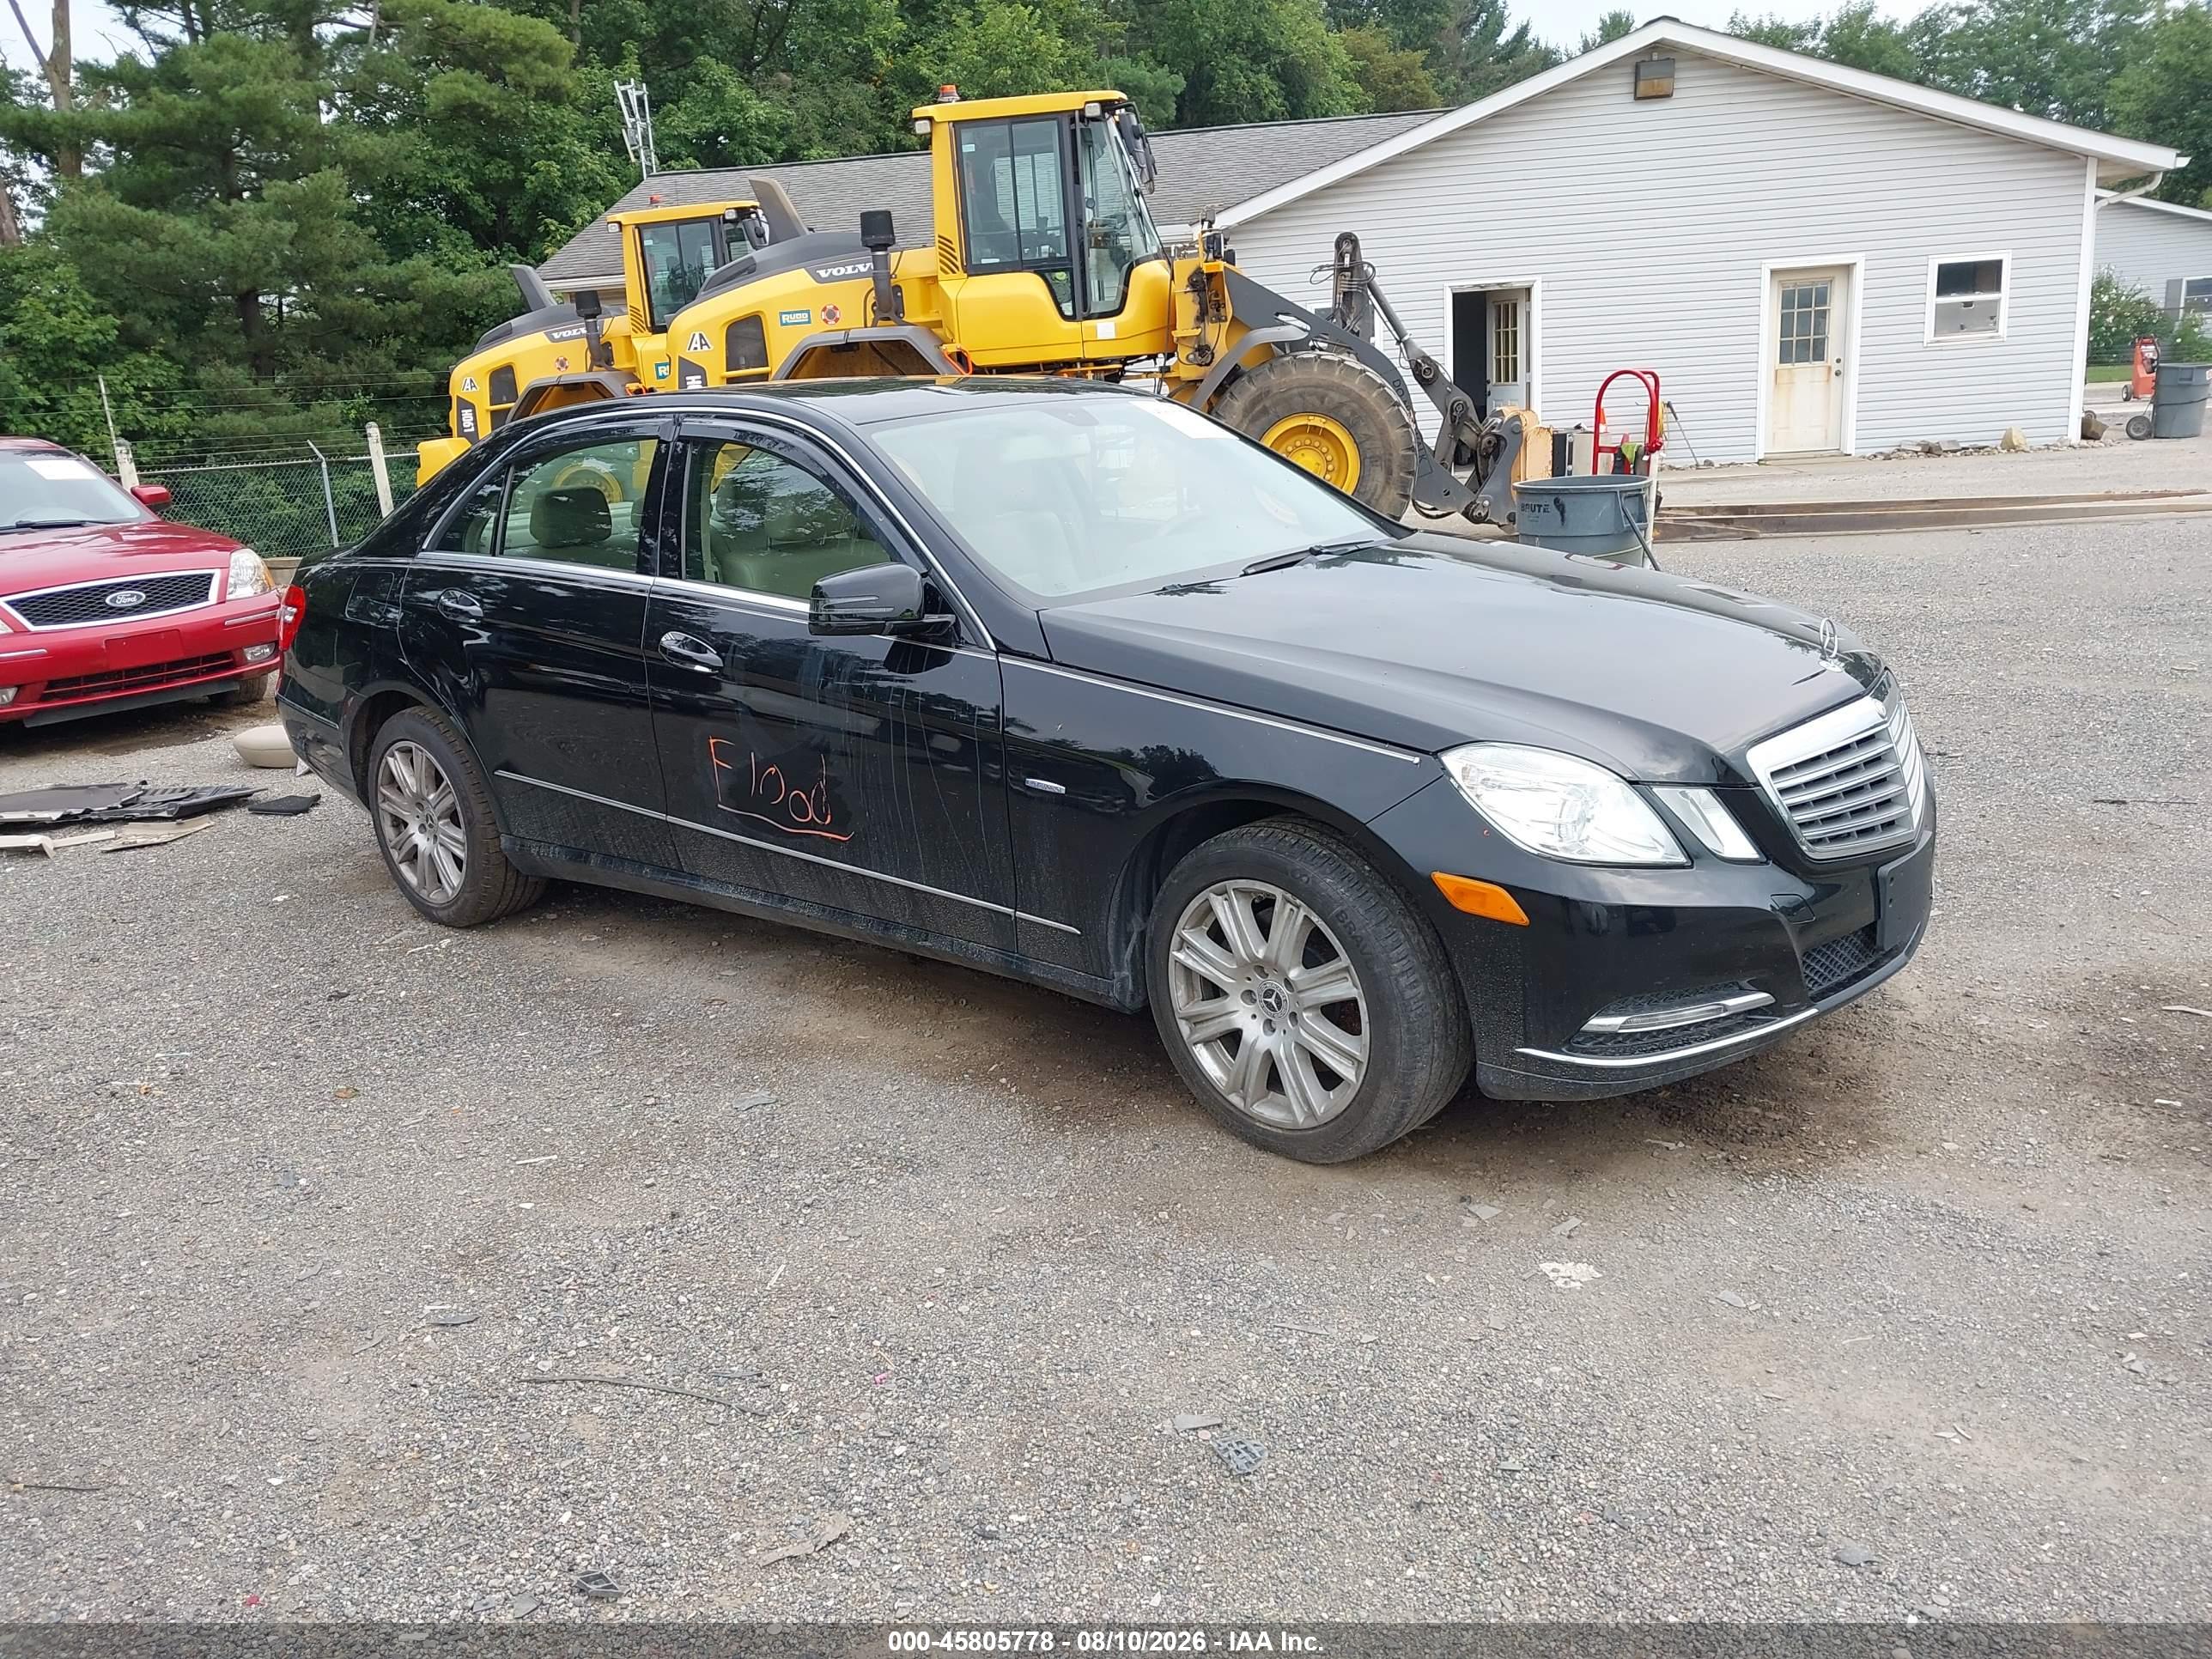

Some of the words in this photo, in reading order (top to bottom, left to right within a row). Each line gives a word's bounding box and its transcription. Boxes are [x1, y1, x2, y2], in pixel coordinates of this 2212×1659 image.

[817, 262, 873, 278] VOLV
[115, 593, 138, 605] Ford
[708, 735, 831, 825] Flood
